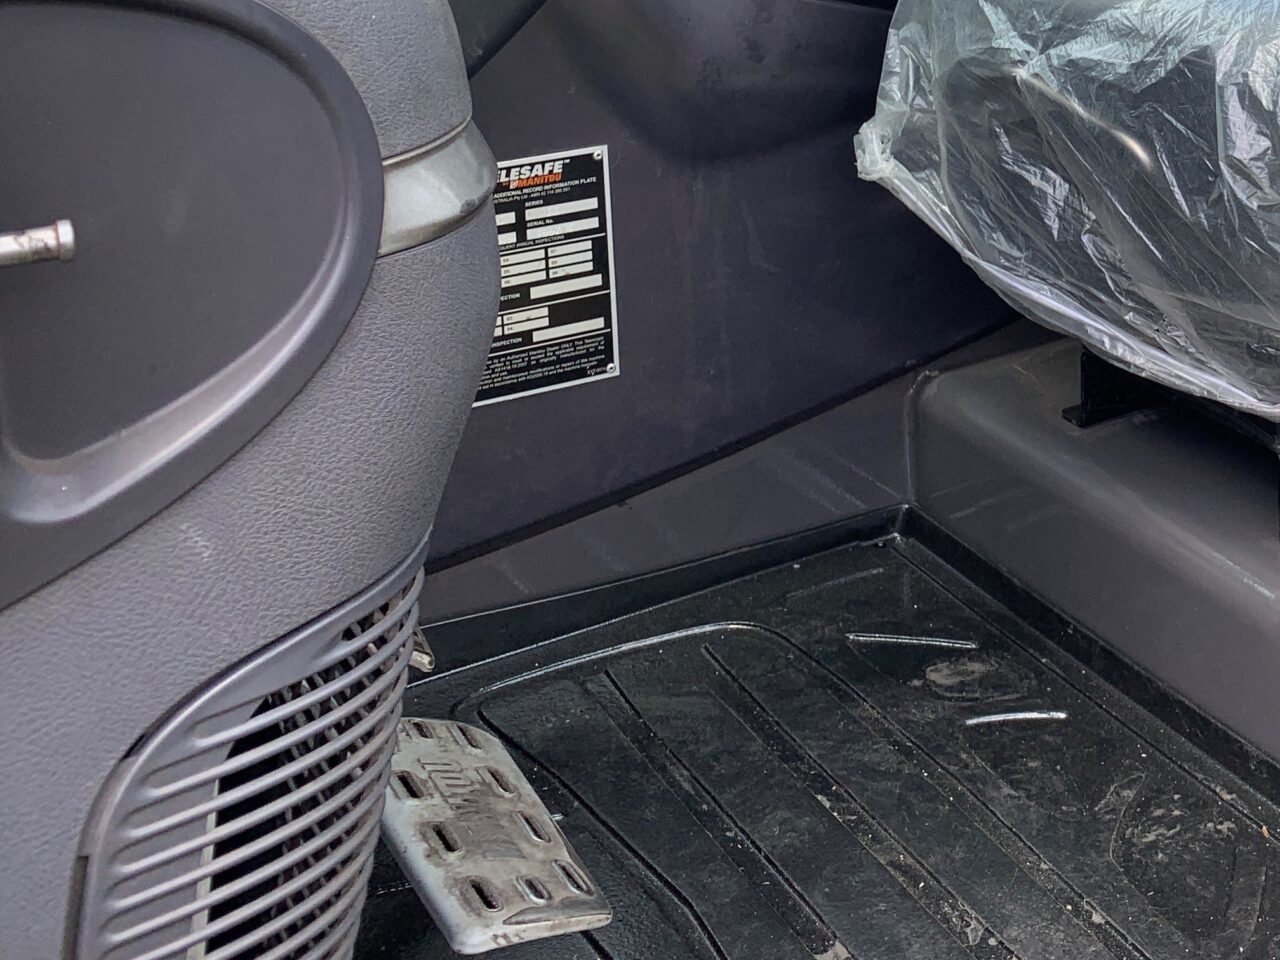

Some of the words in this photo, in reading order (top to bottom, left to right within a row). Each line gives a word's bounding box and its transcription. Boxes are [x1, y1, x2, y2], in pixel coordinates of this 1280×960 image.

[497, 160, 564, 183] LESAFE
[494, 189, 522, 199] ADDITIONAL
[523, 185, 543, 194] RECORD
[544, 180, 580, 190] INFORMATION
[580, 176, 597, 184] PLATE
[518, 172, 562, 188] MANITOU
[525, 199, 543, 207] SERIES
[526, 220, 545, 228] SERIAL
